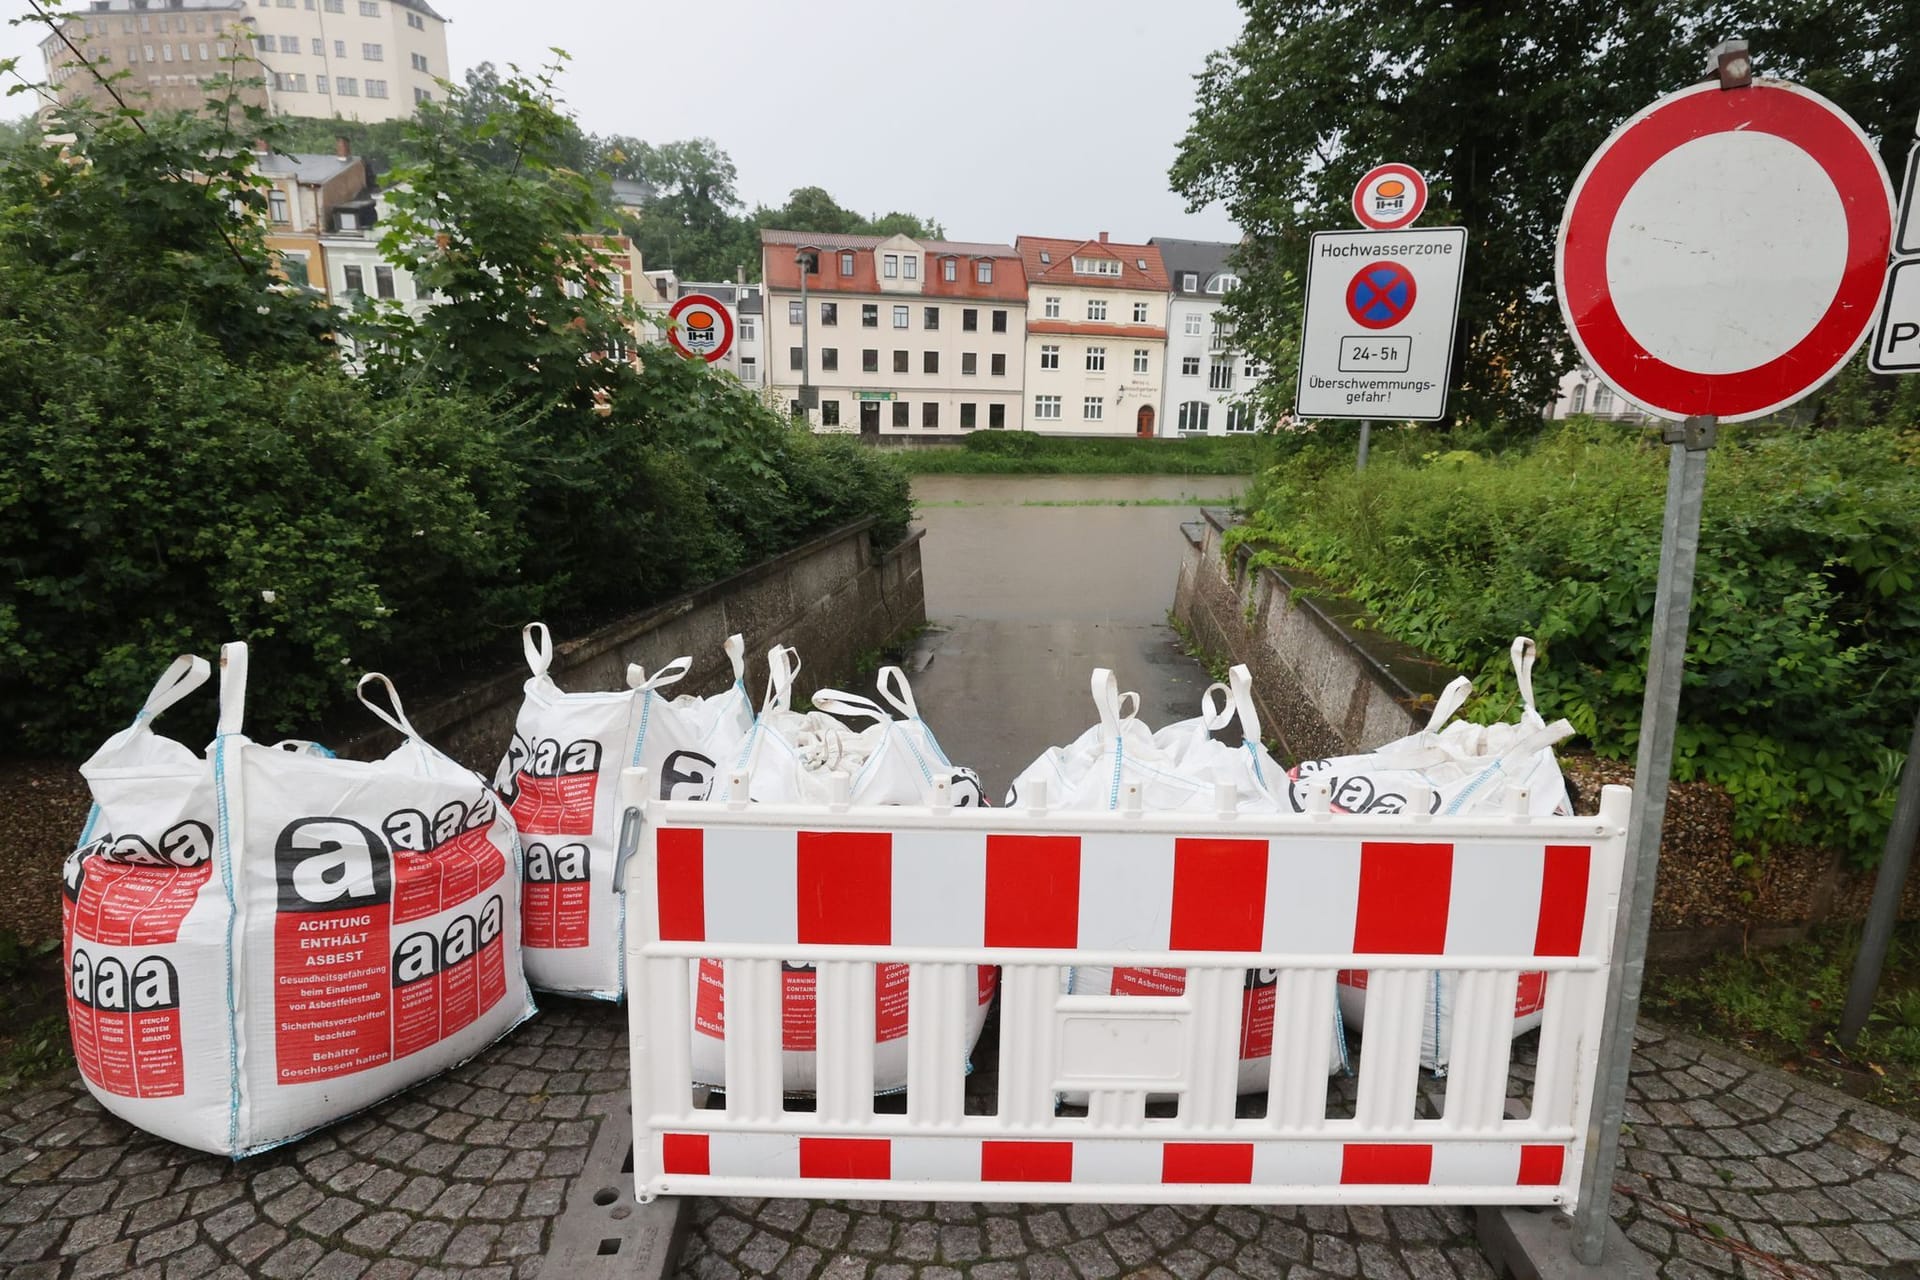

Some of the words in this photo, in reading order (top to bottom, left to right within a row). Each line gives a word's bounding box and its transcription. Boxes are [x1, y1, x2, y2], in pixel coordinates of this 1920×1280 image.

[1321, 243, 1453, 257] Hochwasserzone
[1887, 322, 1920, 353] P
[1309, 375, 1437, 393] Überschwemmungs-
[1346, 391, 1392, 405] gefahr!
[298, 915, 371, 931] ACHTUNG
[300, 932, 368, 949] ENTHÄLT
[306, 950, 364, 966] ASBEST
[300, 988, 323, 997] beim
[326, 982, 368, 995] Einatmen
[289, 1003, 306, 1011] von
[308, 992, 381, 1010] Asbestfeinstaub
[281, 1010, 386, 1031] Sicherheitsvorschriften
[314, 1030, 357, 1042] beachten
[281, 1060, 353, 1077] Geschlossen
[355, 1052, 388, 1065] halten
